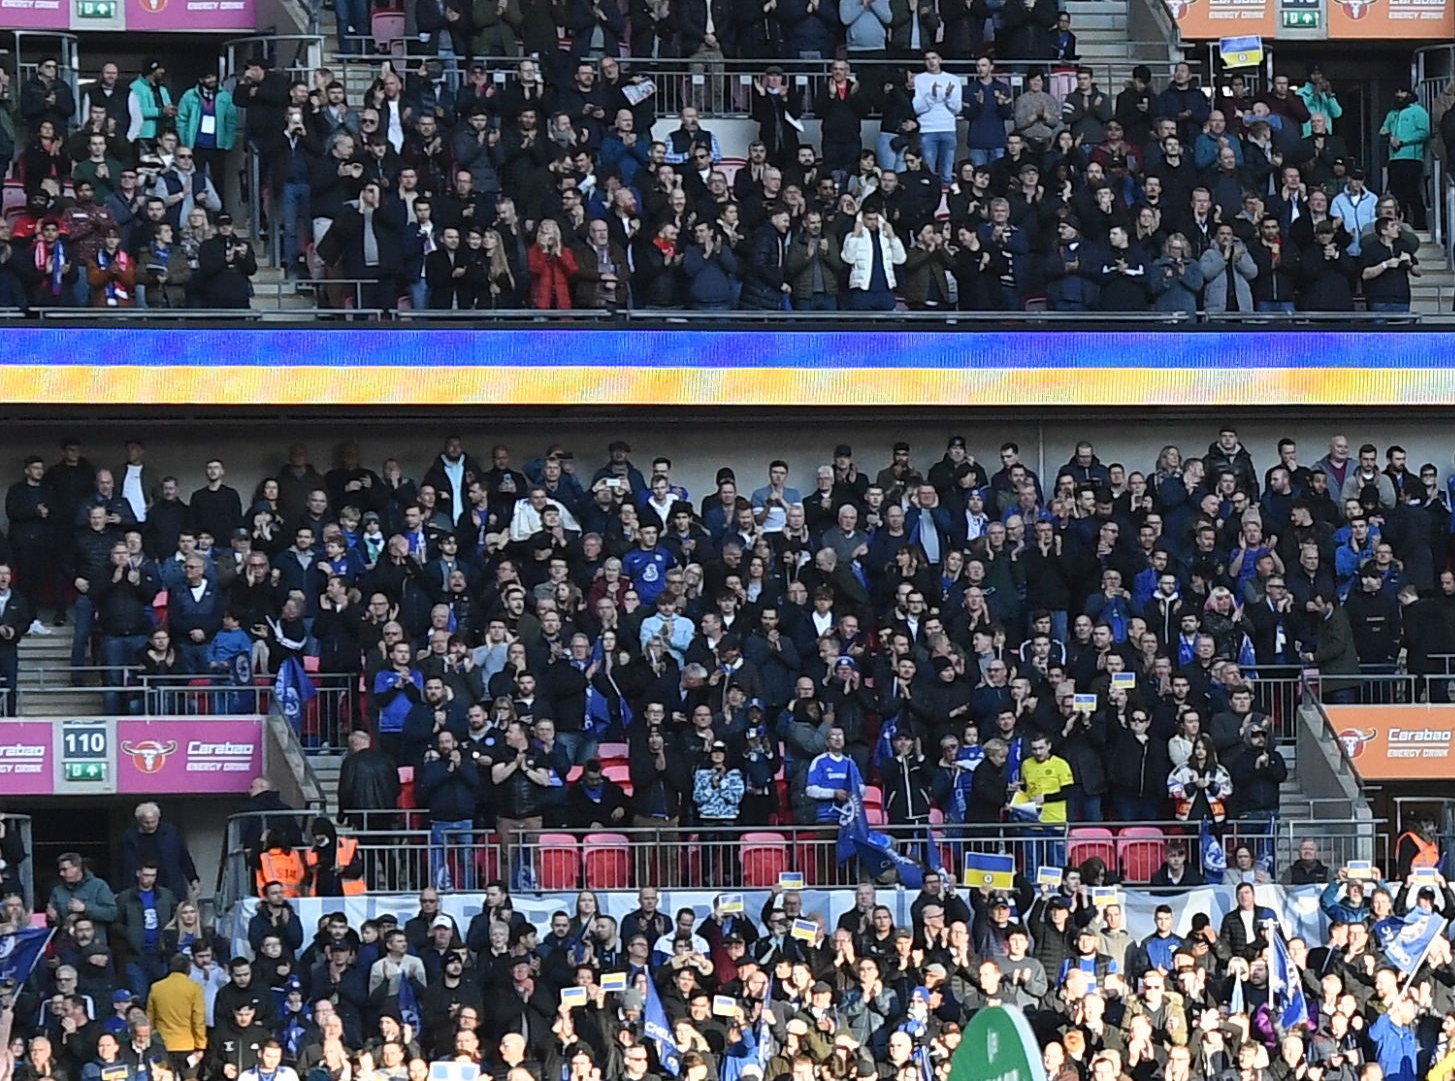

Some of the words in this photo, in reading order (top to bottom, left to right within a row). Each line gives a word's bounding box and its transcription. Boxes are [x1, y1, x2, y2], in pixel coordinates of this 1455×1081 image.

[1387, 728, 1452, 742] Carabao
[65, 733, 105, 753] 110
[187, 741, 254, 756] Carabao
